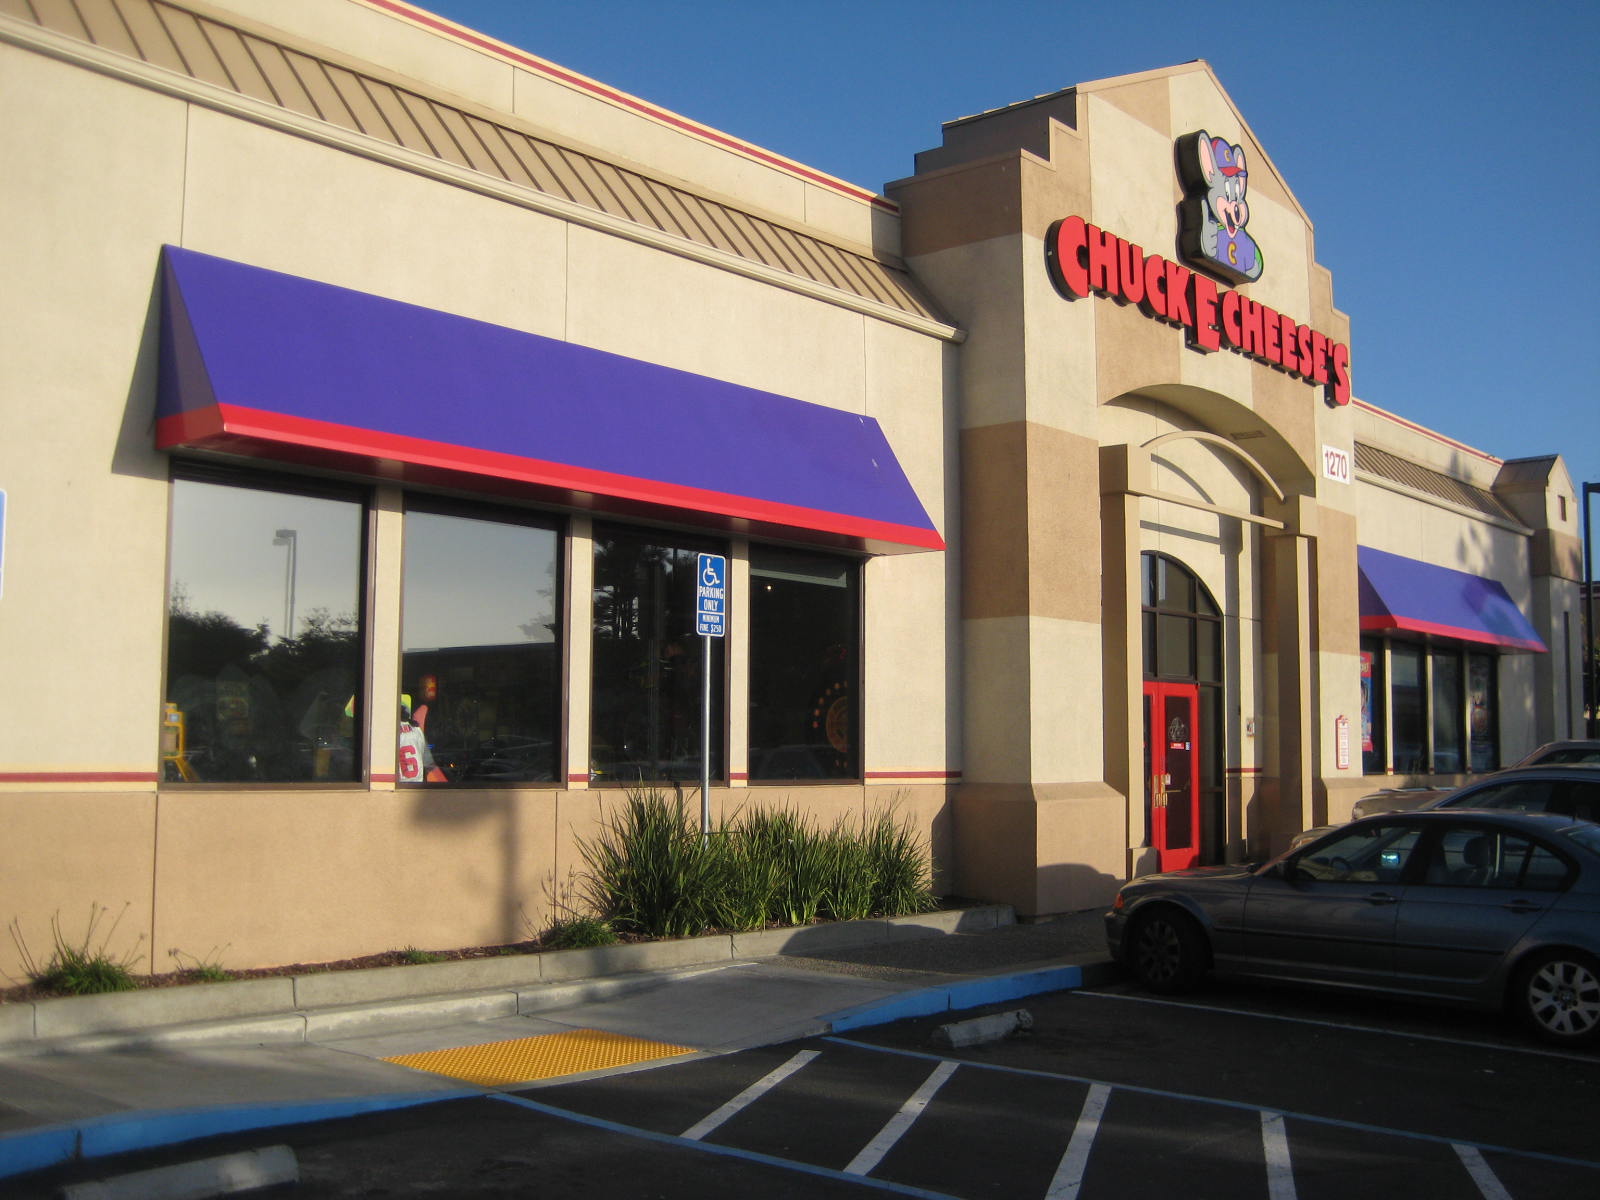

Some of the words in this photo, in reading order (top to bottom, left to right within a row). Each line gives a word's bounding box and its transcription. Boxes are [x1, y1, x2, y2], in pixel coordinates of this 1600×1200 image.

[1228, 241, 1238, 266] C
[1056, 215, 1192, 326] CHUCK
[1193, 275, 1220, 352] E
[1221, 290, 1351, 406] CHEESE'S
[1323, 449, 1348, 479] 1270
[699, 586, 723, 599] PARKING
[703, 599, 718, 611] ONLY
[703, 614, 719, 623] MINIMUM
[710, 624, 722, 633] $250
